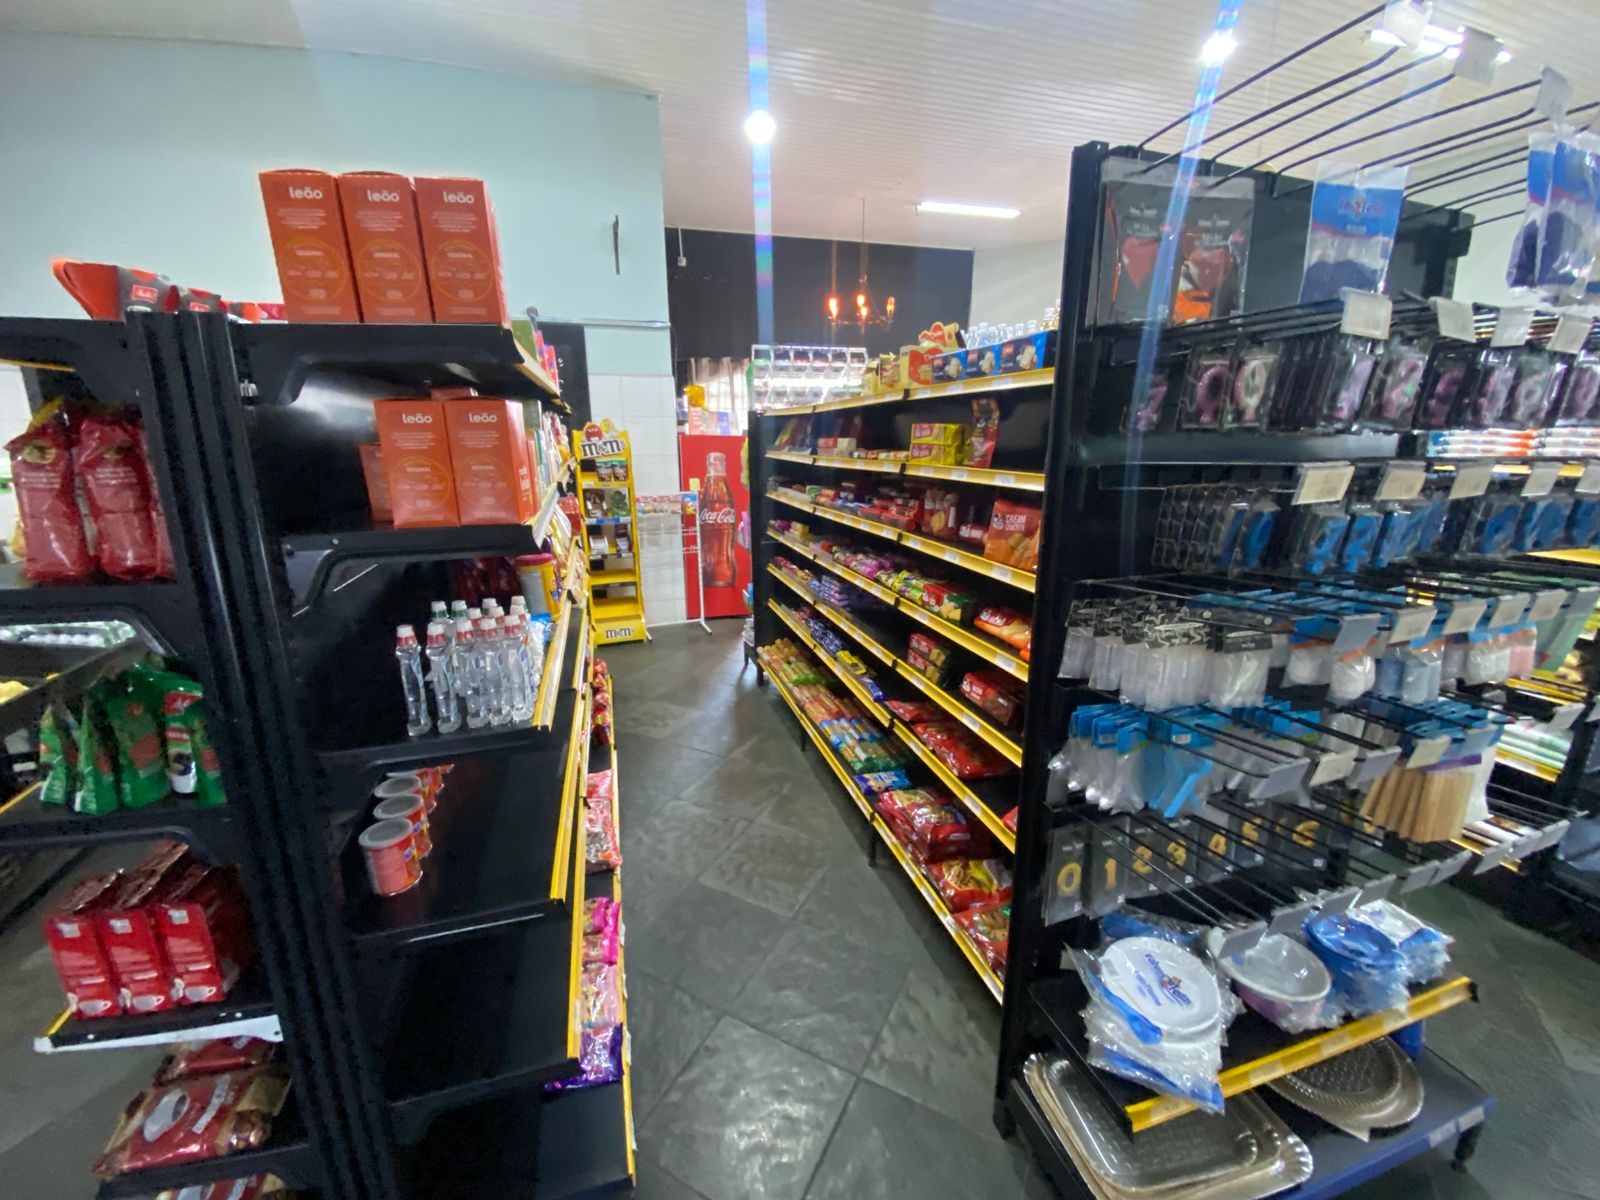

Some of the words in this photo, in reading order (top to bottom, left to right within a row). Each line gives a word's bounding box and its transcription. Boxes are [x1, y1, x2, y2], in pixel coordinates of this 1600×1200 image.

[288, 187, 323, 199] leão
[367, 190, 400, 202] leão
[443, 191, 475, 204] leão
[402, 413, 433, 424] leão
[469, 413, 497, 423] leão
[1005, 514, 1026, 524] CREAM
